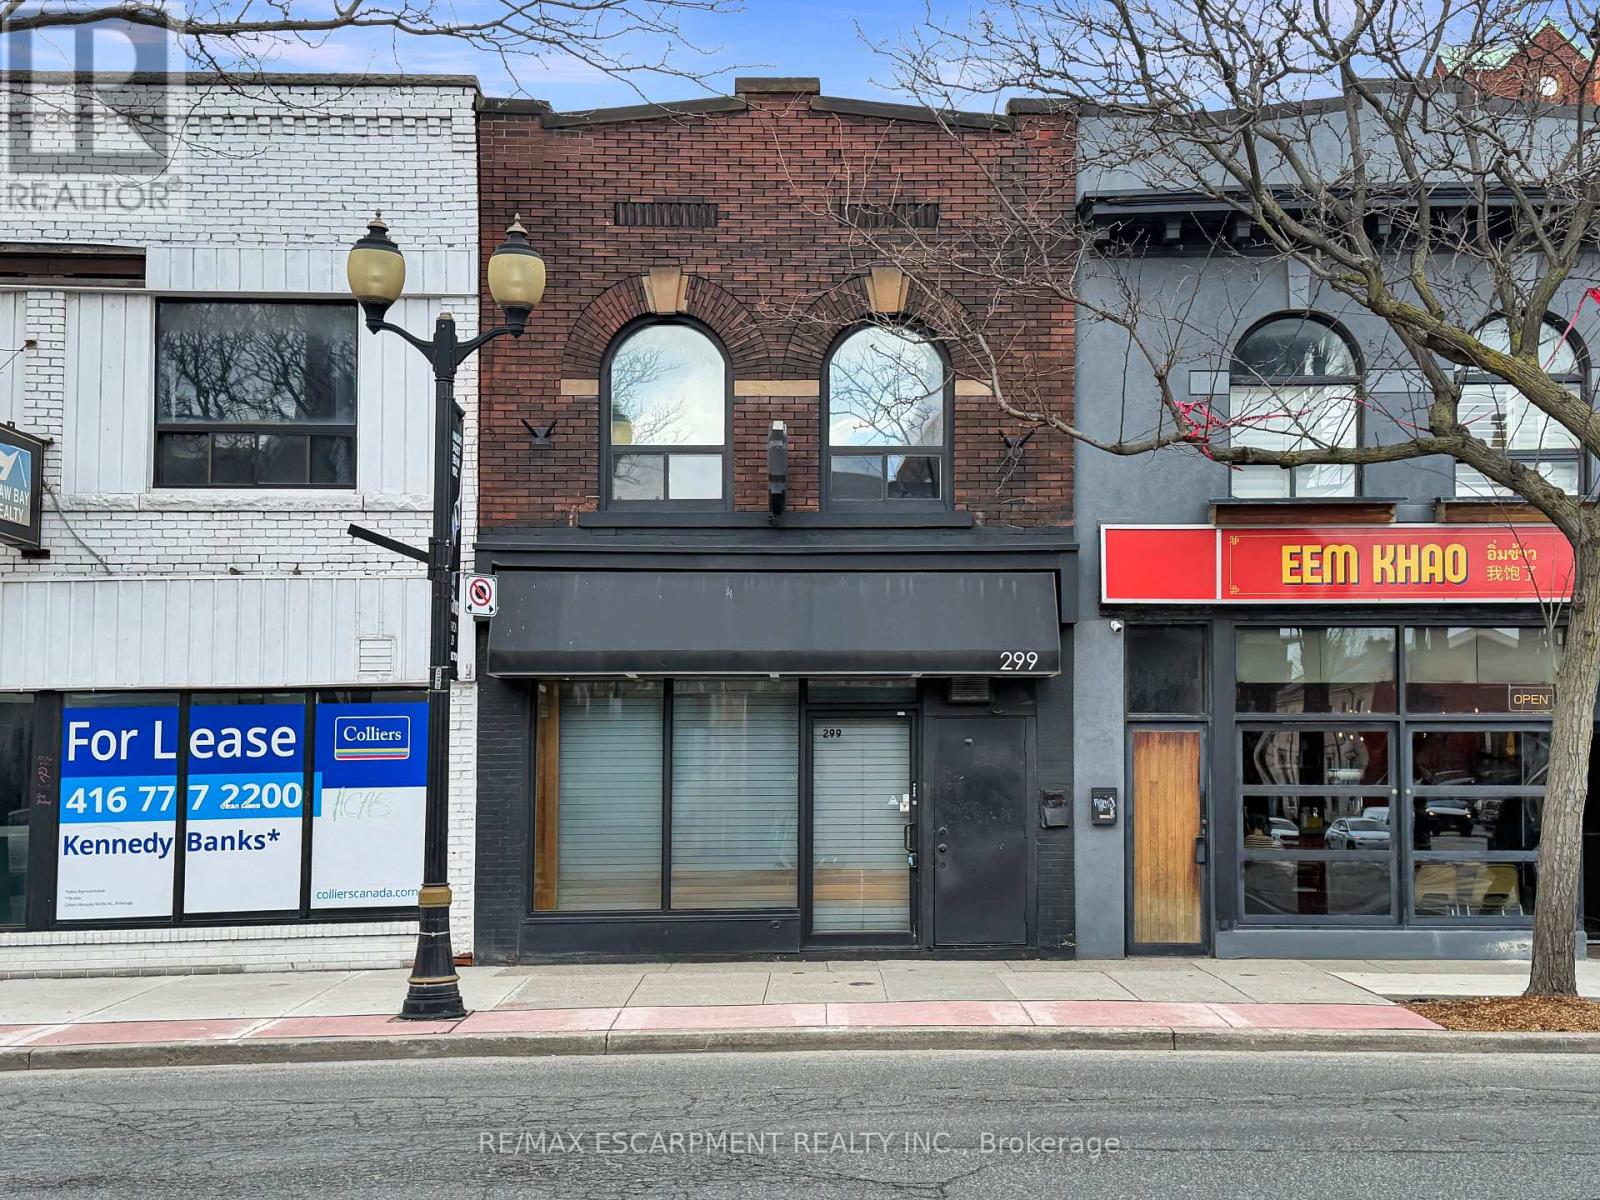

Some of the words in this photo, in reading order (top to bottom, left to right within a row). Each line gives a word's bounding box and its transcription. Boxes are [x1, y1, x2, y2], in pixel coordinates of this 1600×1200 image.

[13, 488, 29, 506] BAY
[1372, 544, 1468, 585] KHAO
[1000, 651, 1038, 671] 299
[1513, 694, 1548, 705] OPEN
[68, 721, 139, 761] For
[343, 726, 402, 742] Colliers
[823, 728, 842, 739] 299
[65, 786, 128, 814] 416
[220, 782, 303, 810] 2200
[63, 832, 174, 860] Kennedy
[316, 888, 418, 900] collierscanada.com
